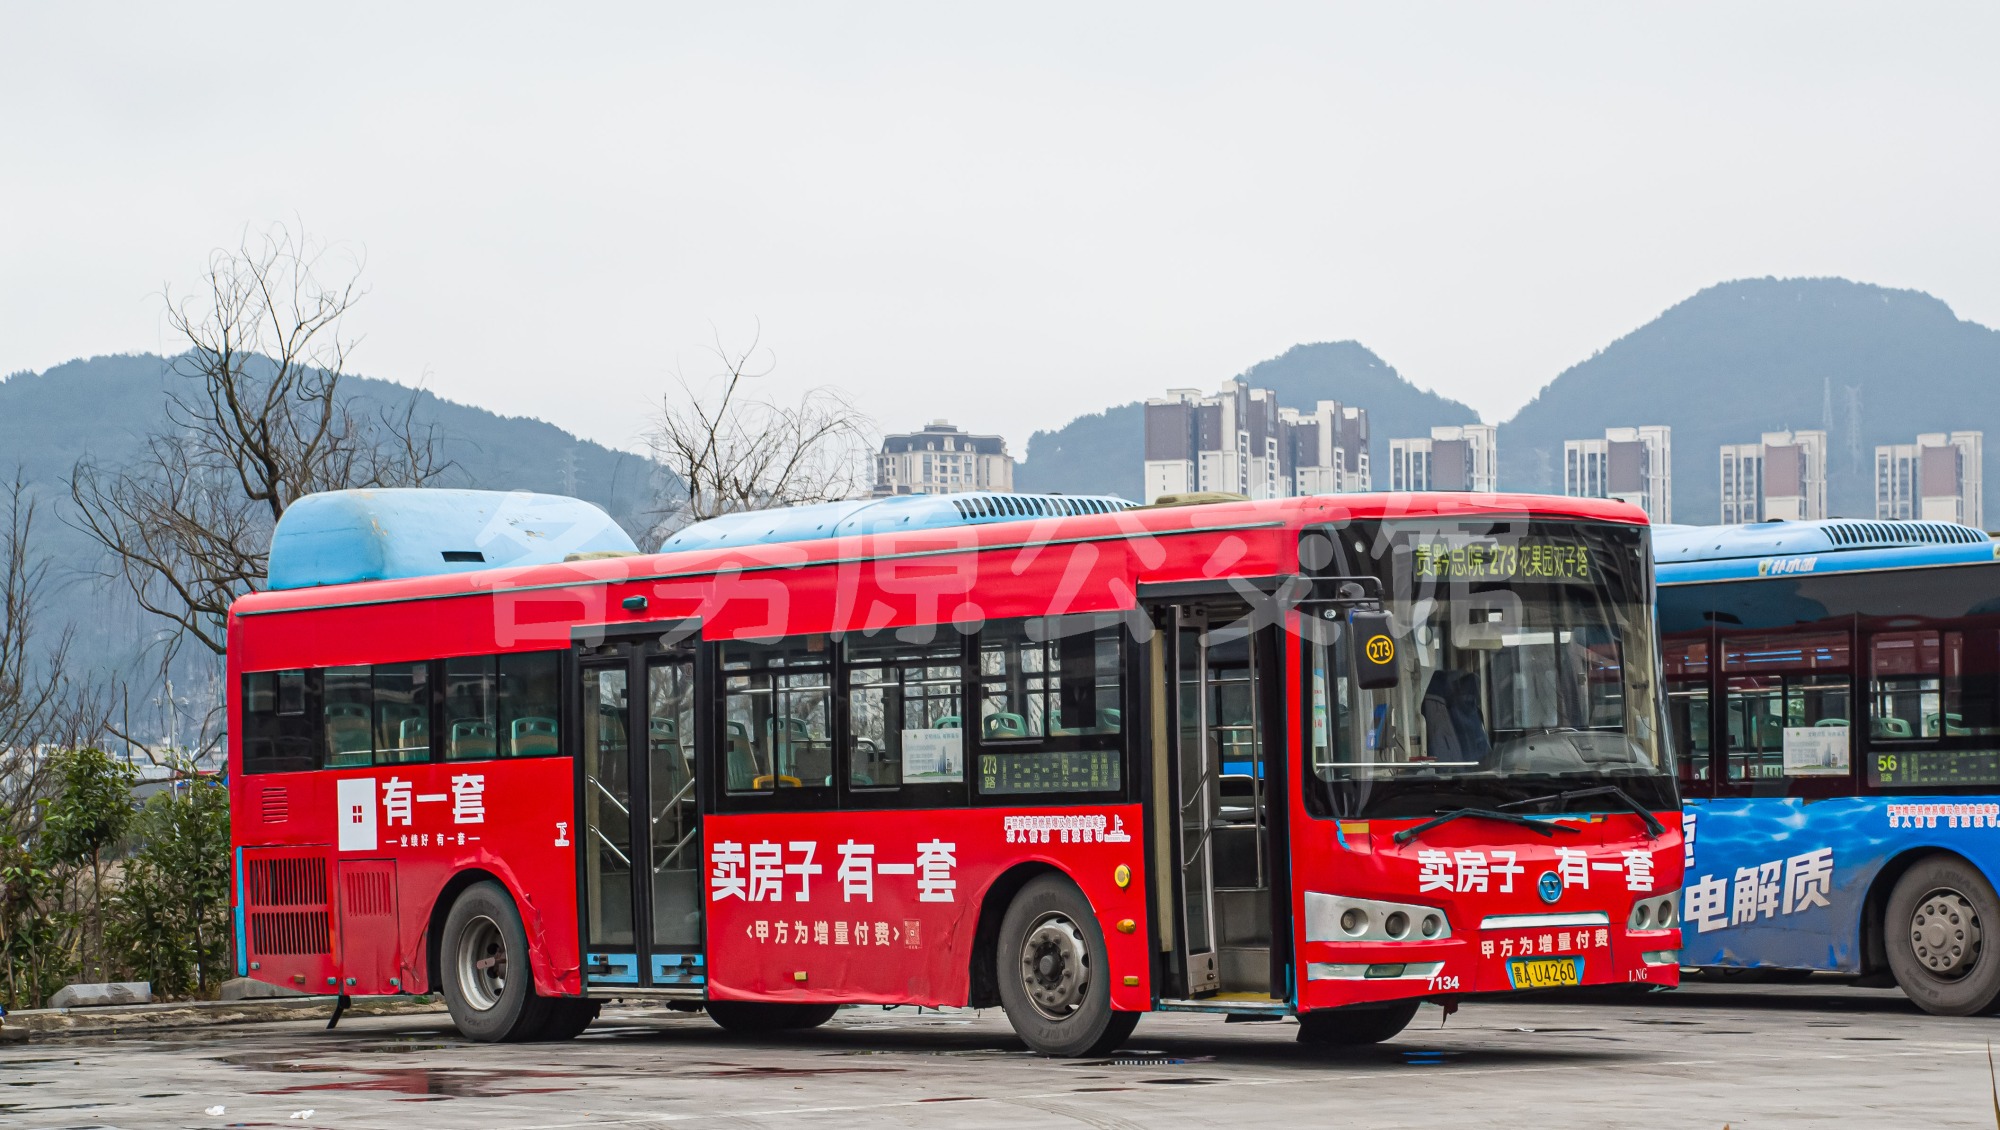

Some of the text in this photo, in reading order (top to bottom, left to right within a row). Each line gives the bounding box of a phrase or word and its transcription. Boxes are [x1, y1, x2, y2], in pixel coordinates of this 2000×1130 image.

[1416, 544, 1588, 577] 贵黔总院 273 花果园双子塔
[1371, 641, 1390, 658] 273
[983, 756, 997, 775] 273
[1877, 755, 1897, 772] 56
[984, 776, 996, 789] 路
[382, 773, 485, 826] 有一套
[556, 822, 568, 840] 下
[1110, 814, 1124, 836] 上
[400, 832, 466, 847] 业绩好 有一套
[711, 838, 957, 903] 卖房子 有一套
[1417, 847, 1654, 893] 卖房子 有一套
[1684, 847, 1833, 933] 电解质
[1480, 929, 1608, 959] 甲方为增量付费
[1427, 976, 1460, 991] 7134
[1628, 967, 1648, 983] LNG
